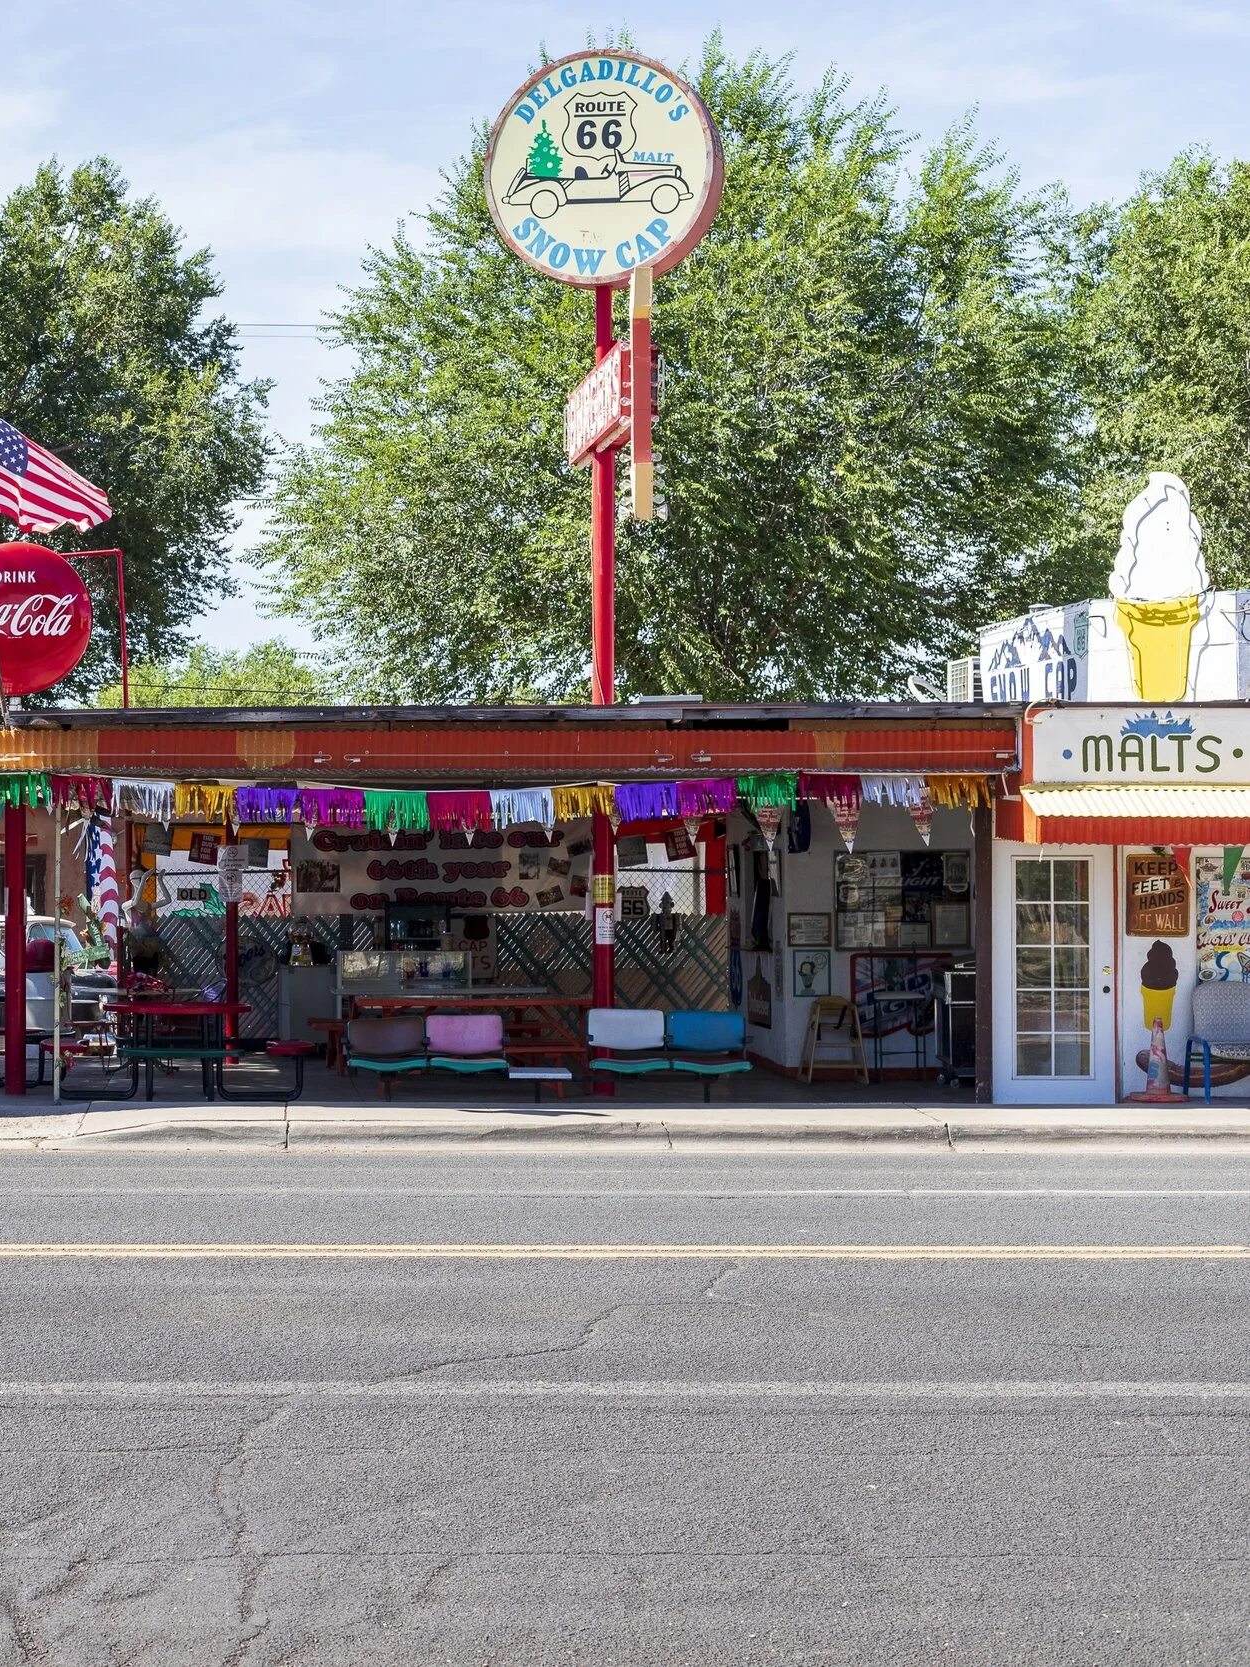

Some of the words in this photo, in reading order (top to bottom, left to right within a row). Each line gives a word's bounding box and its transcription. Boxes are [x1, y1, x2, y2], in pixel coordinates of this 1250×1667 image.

[514, 59, 690, 124] DELGADILLO'S
[575, 101, 626, 113] ROUTE
[576, 119, 622, 150] 66
[632, 151, 675, 163] MALT
[513, 217, 607, 276] SNOW
[616, 218, 672, 269] CAP
[990, 667, 1030, 702] SNOW
[1045, 658, 1078, 701] CAP
[1082, 735, 1223, 773] MALTS
[313, 830, 435, 851] Cruisin'
[439, 829, 504, 849] into
[508, 831, 565, 848] our
[367, 858, 439, 881] 66th
[442, 861, 512, 883] year
[1134, 861, 1178, 875] KEEP
[180, 889, 207, 900] OLD
[1132, 877, 1170, 895] FEET
[350, 893, 390, 910] on
[491, 886, 529, 908] 66
[622, 899, 644, 915] 66
[1139, 890, 1185, 910] HANDS
[1208, 889, 1244, 914] SWEET
[1155, 913, 1185, 930] WALL
[458, 940, 488, 952] CAP
[471, 955, 491, 970] TS
